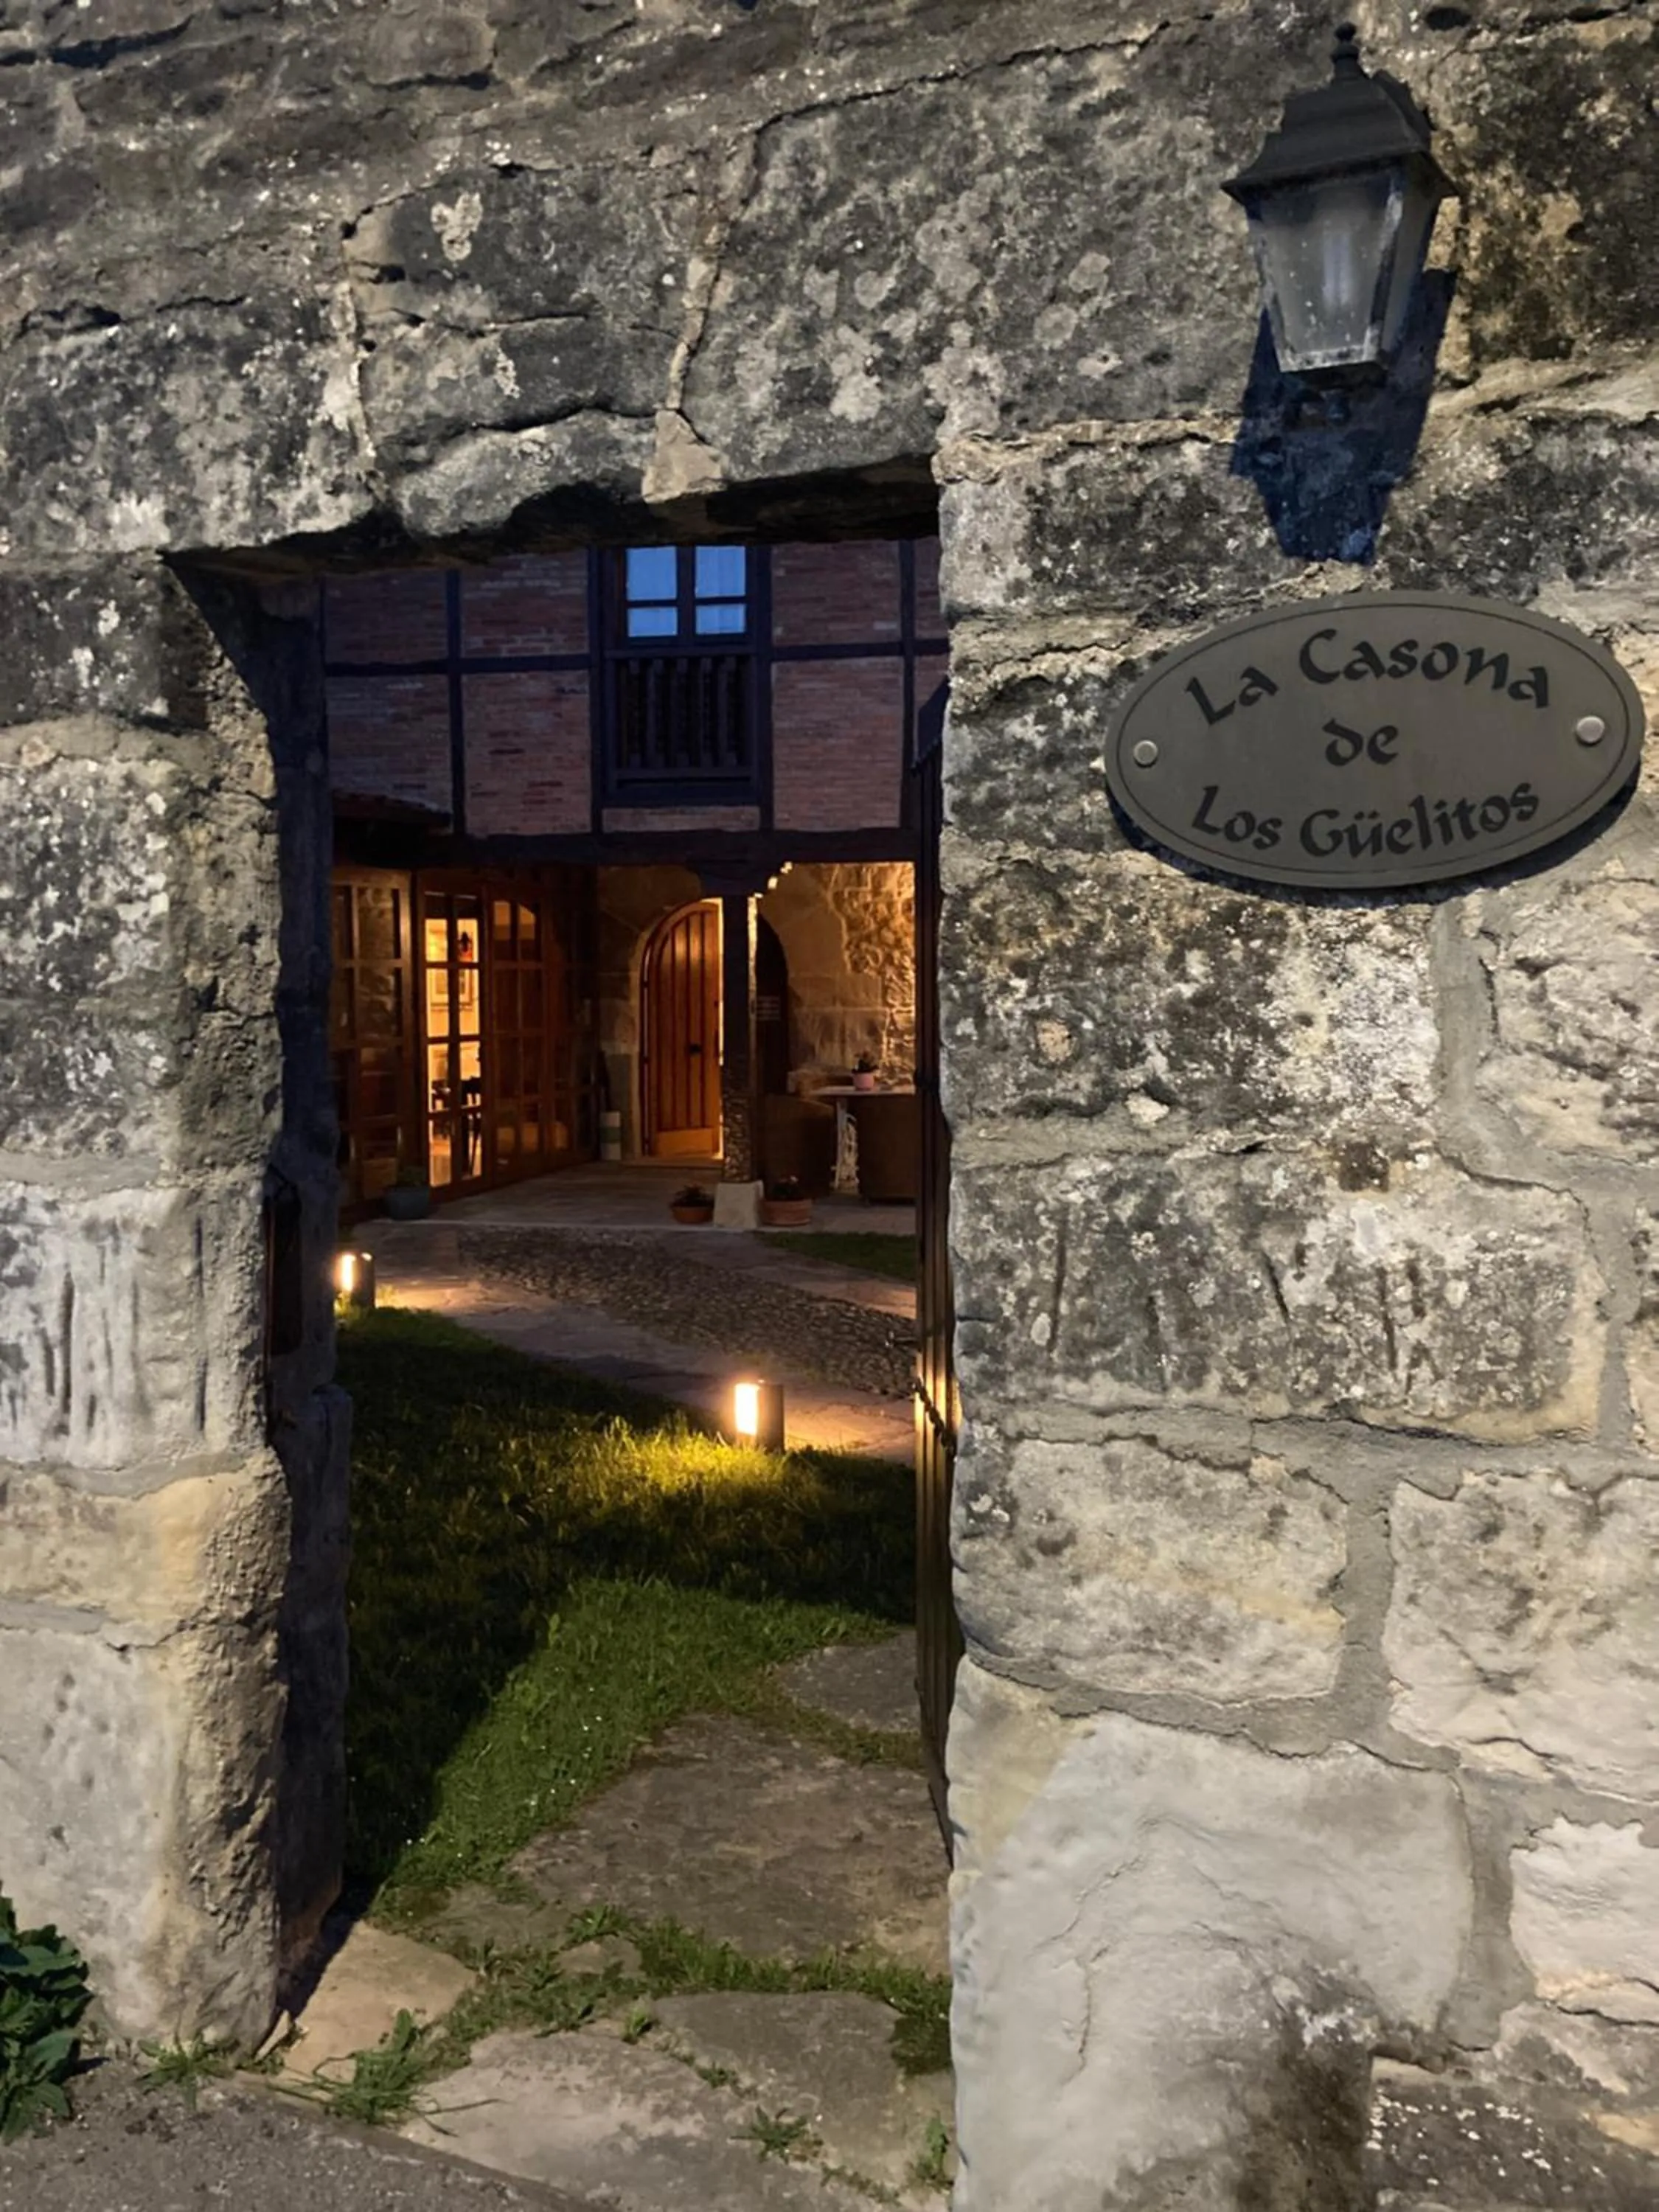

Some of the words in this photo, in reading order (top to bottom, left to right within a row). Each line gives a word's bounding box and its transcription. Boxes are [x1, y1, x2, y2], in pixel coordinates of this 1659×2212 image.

[1186, 666, 1279, 726] La
[1299, 628, 1549, 709] Casona
[1322, 719, 1399, 767] de
[1191, 785, 1283, 851] Los
[1299, 782, 1540, 858] Güelitos
